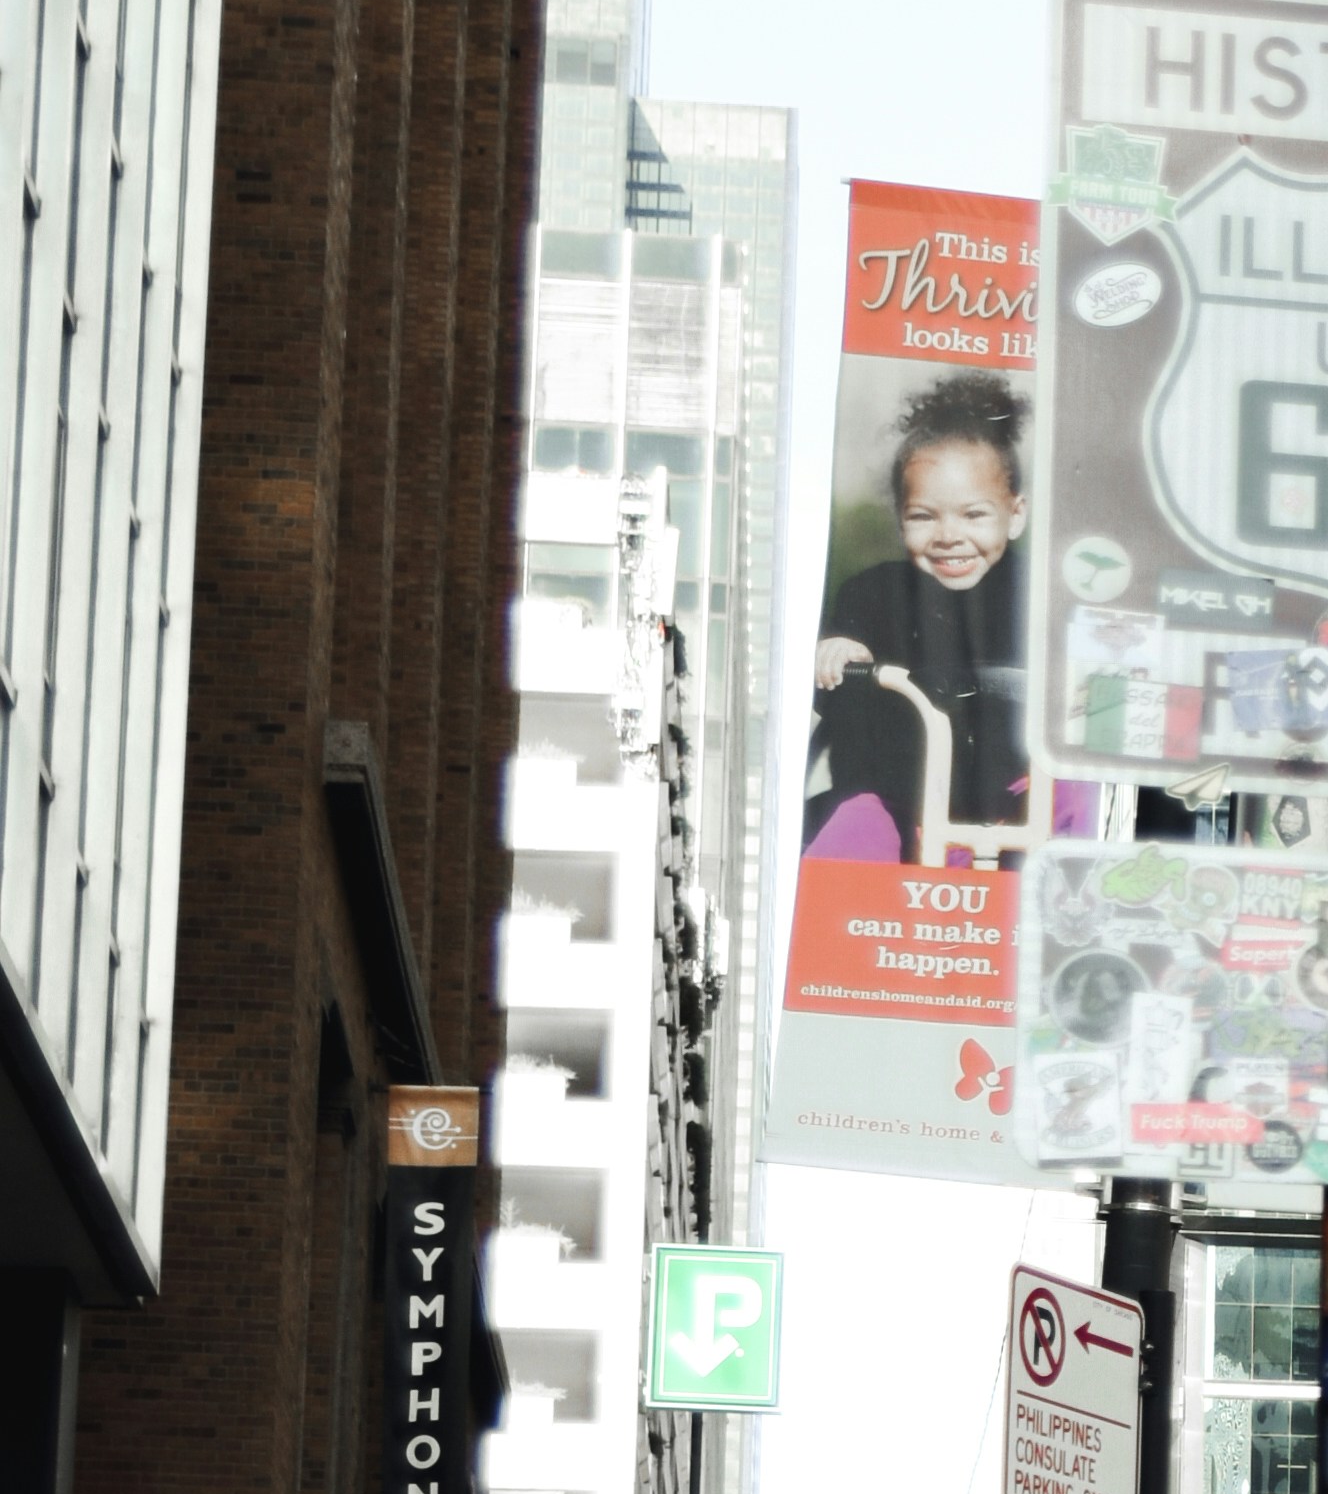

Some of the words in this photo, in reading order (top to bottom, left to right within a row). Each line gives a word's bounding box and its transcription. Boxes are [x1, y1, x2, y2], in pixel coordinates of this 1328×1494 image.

[935, 231, 1008, 264] This
[902, 321, 990, 355] looks
[902, 881, 990, 914] YOU
[847, 918, 904, 939] can
[913, 921, 1001, 946] make
[875, 945, 1000, 980] happen.
[797, 1111, 911, 1135] children's
[919, 1121, 981, 1142] home
[1141, 1114, 1186, 1130] Fuck
[1190, 1115, 1248, 1134] Trump
[1016, 1403, 1102, 1454] PHILIPPINES
[1015, 1437, 1097, 1485] CONSULATE
